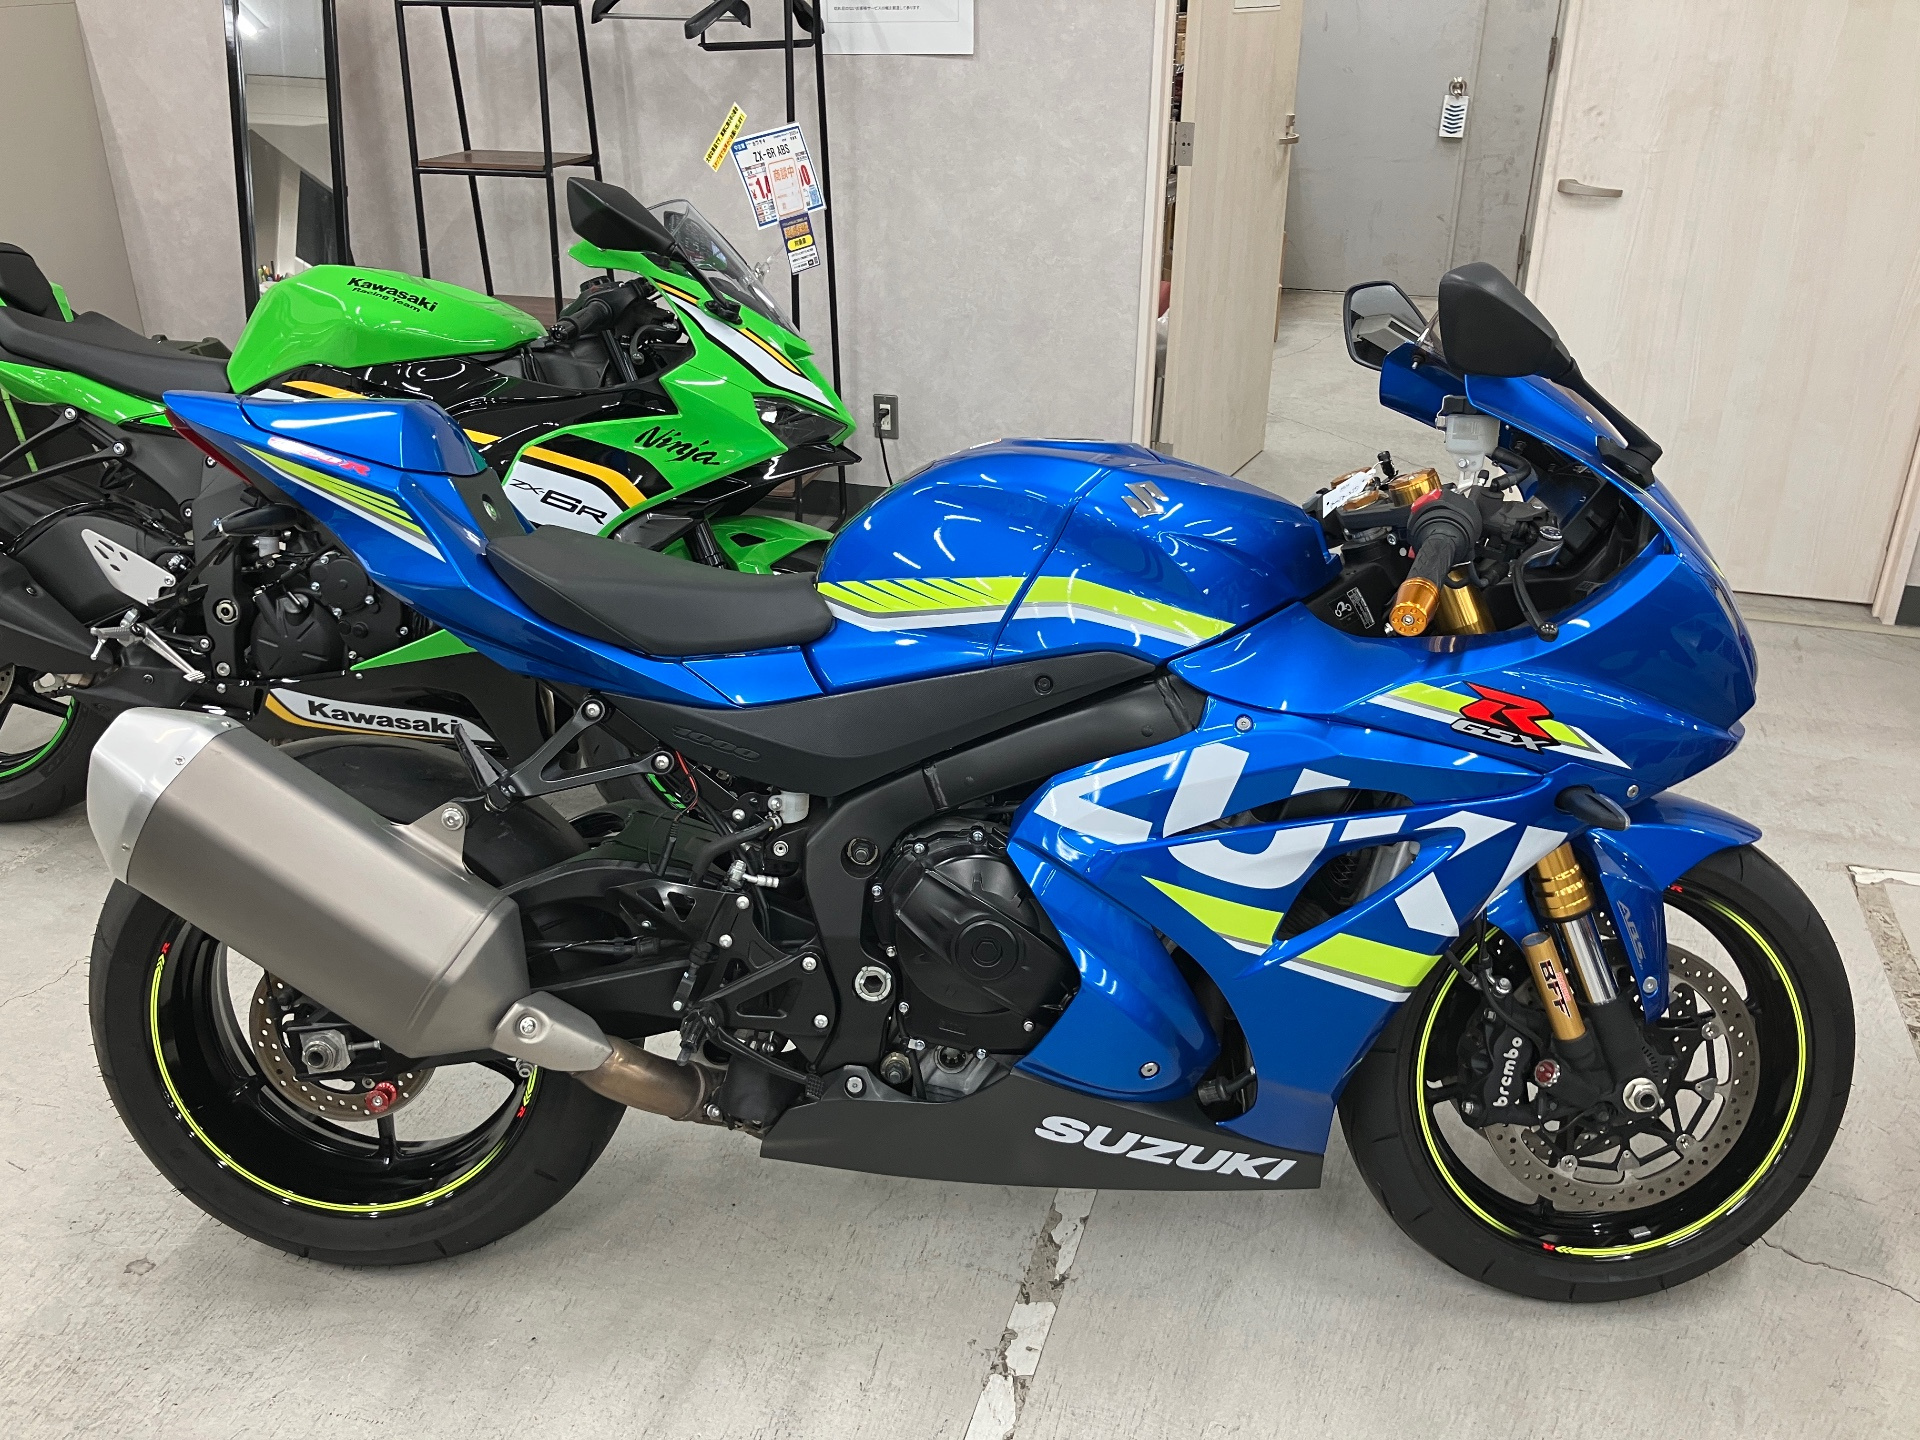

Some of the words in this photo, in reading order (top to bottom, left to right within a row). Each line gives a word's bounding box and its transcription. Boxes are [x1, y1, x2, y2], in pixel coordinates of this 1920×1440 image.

[752, 147, 777, 162] ZX-6R
[776, 143, 790, 156] ABS
[347, 277, 438, 312] Kawasaki
[352, 287, 389, 300] Racing
[392, 297, 420, 312] Team
[634, 426, 720, 466] Ninja
[509, 478, 608, 525] ZX-6R
[308, 700, 459, 735] Kawasaki
[1451, 719, 1550, 751] GSX
[1492, 1036, 1523, 1107] brembo
[1034, 1115, 1297, 1181] SUZUKI
